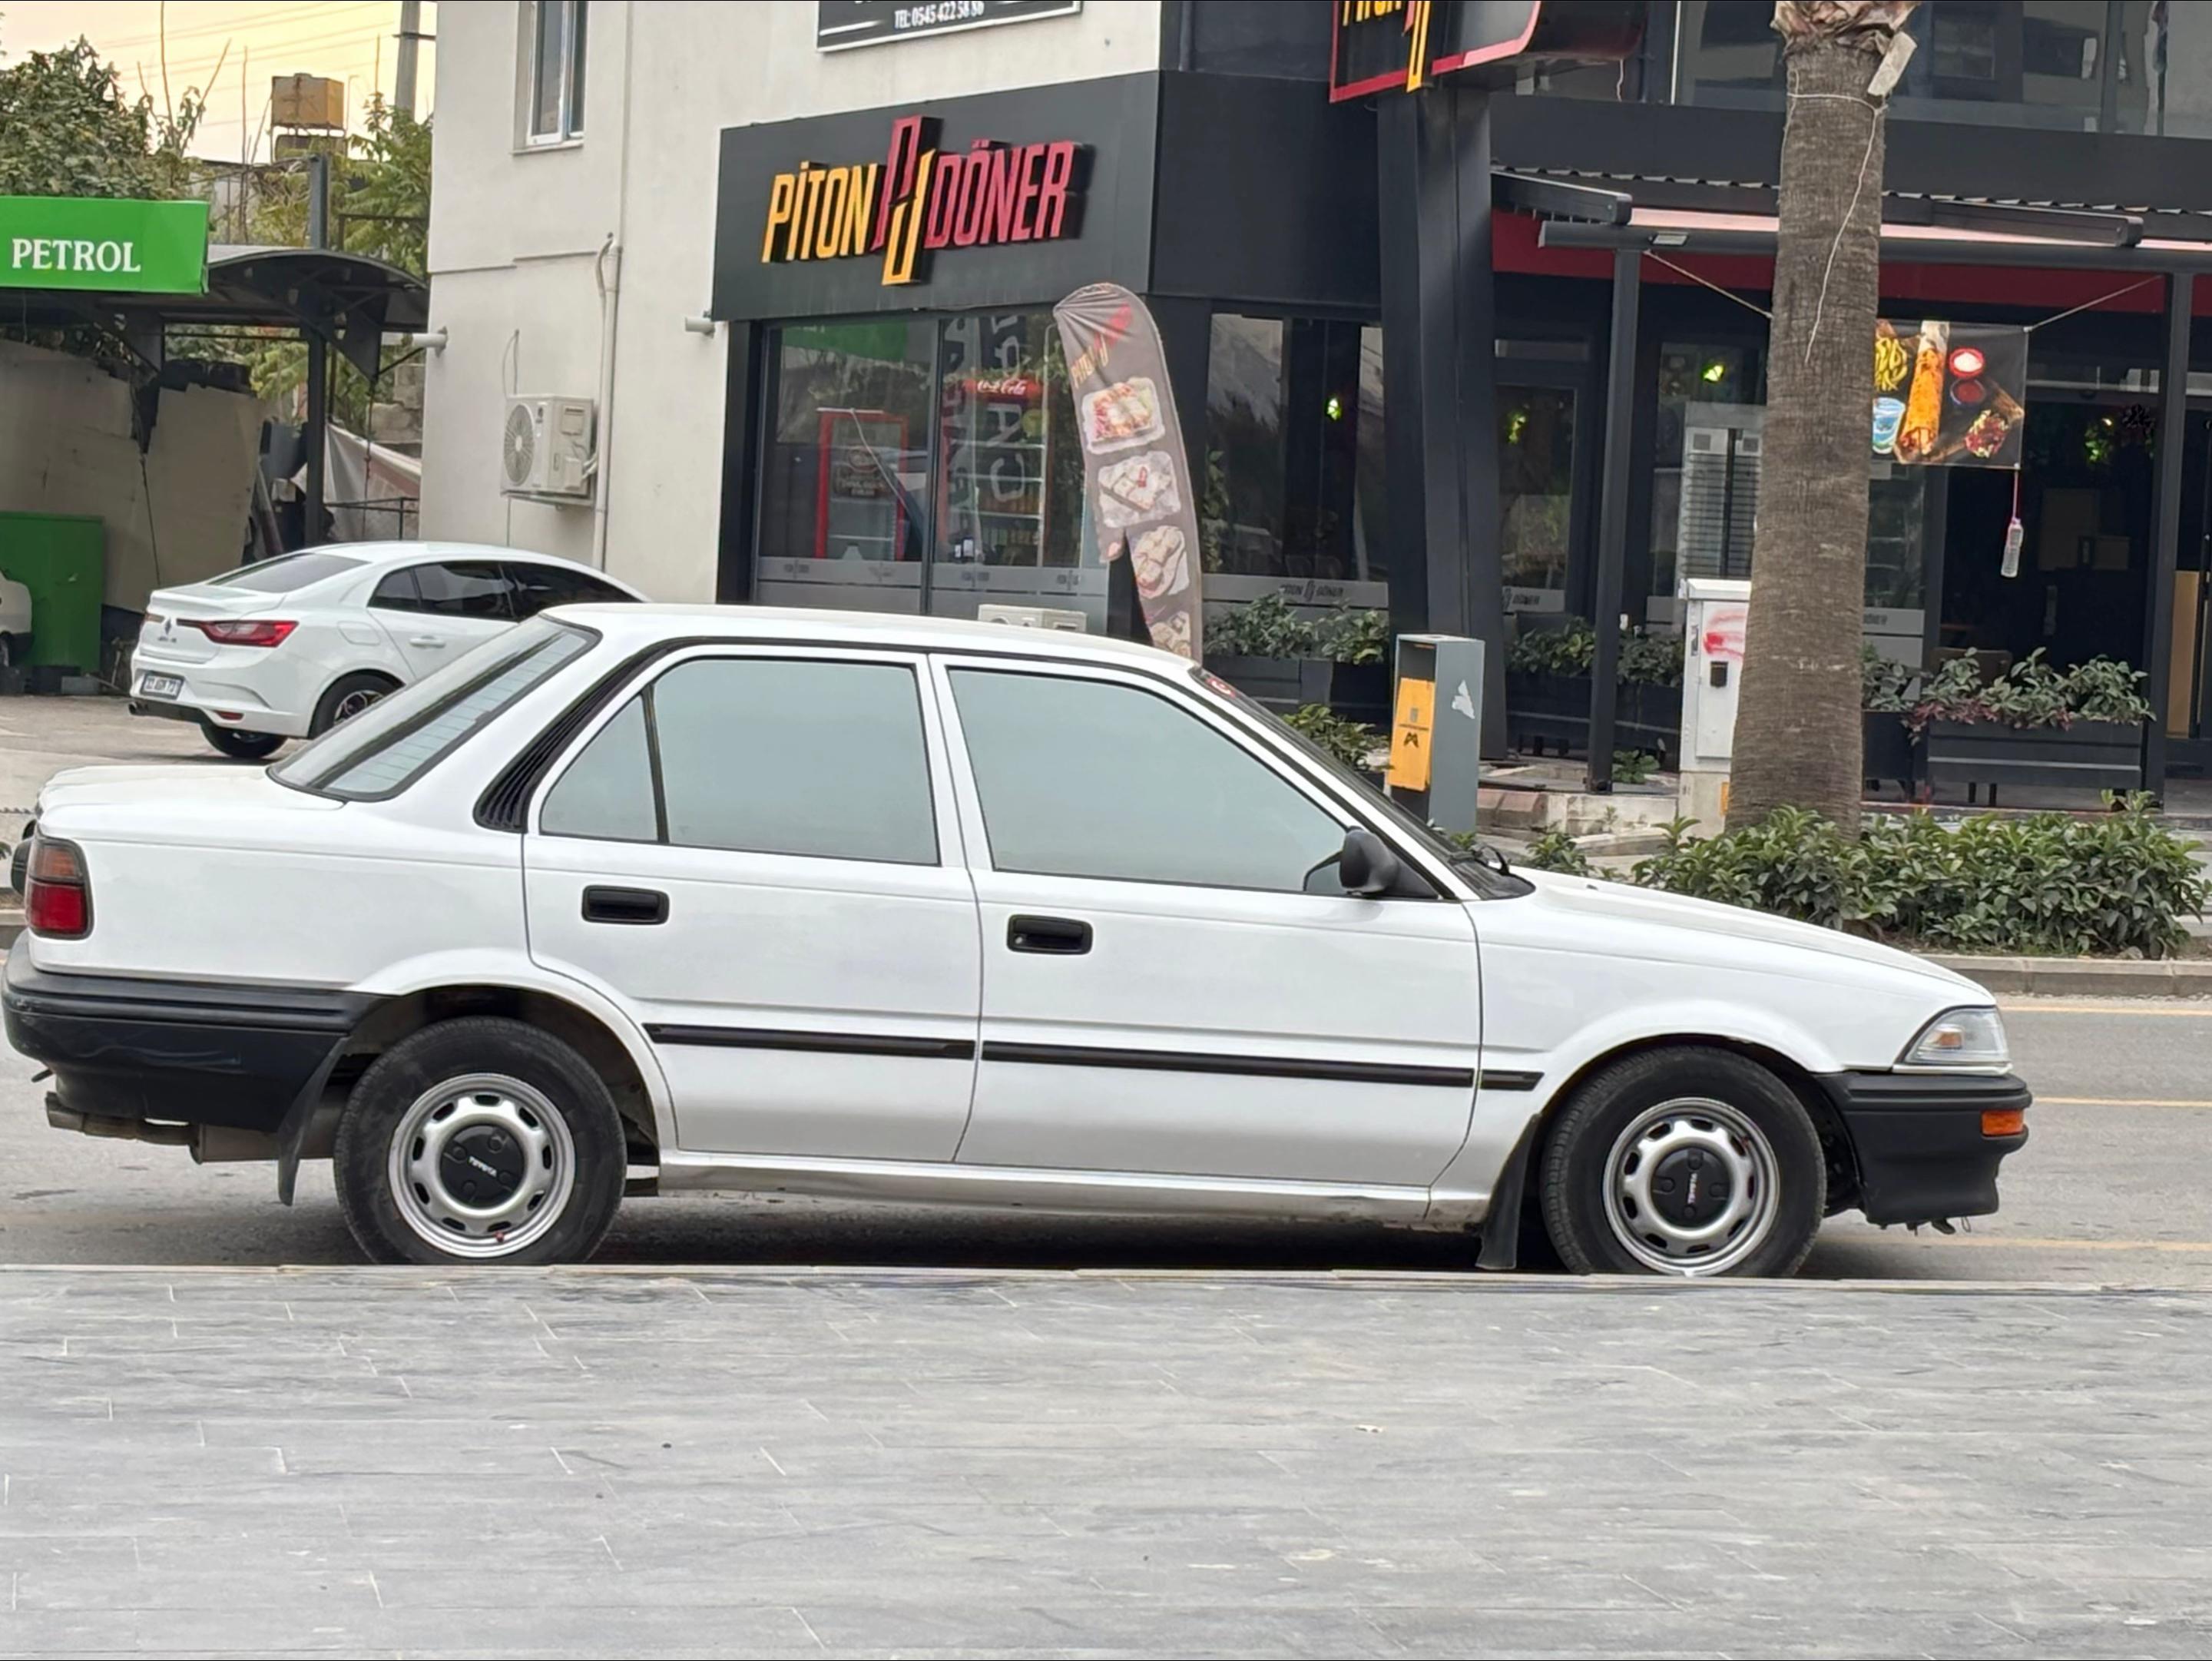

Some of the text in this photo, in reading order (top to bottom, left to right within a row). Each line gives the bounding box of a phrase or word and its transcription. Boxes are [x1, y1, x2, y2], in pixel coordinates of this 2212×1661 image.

[761, 139, 1075, 263] PİTON DÖNER
[12, 238, 141, 272] PETROL
